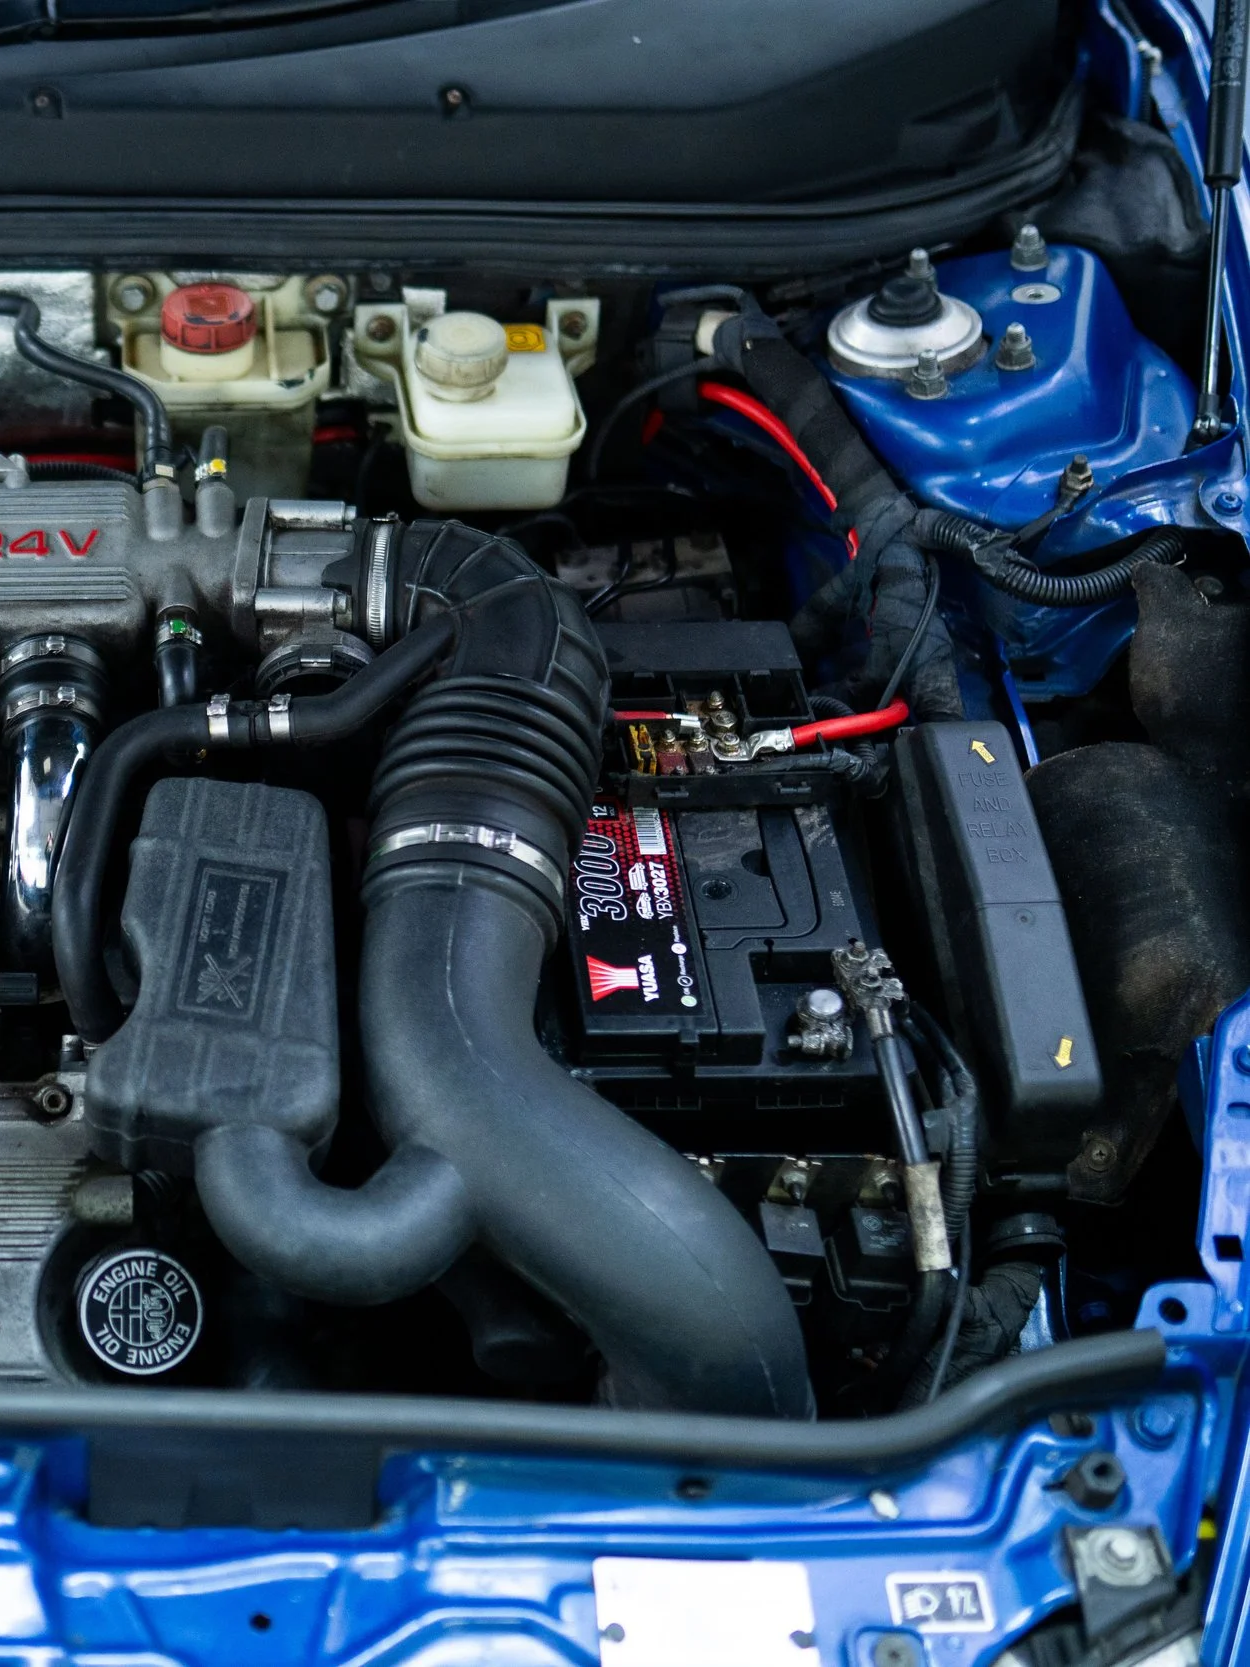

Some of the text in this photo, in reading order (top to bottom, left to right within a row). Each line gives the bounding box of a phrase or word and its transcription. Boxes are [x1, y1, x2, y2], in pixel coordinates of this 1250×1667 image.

[957, 772, 1010, 789] FUSE
[592, 805, 608, 818] 12
[972, 796, 1012, 813] AND
[966, 821, 1029, 838] RELAY
[987, 847, 1028, 863] BOX
[573, 832, 628, 921] 3000
[649, 861, 674, 920] YBX3027
[637, 954, 659, 1002] YUASA
[92, 1259, 189, 1304] ENGINE OIL
[96, 1322, 191, 1366] ENGINE OIL
